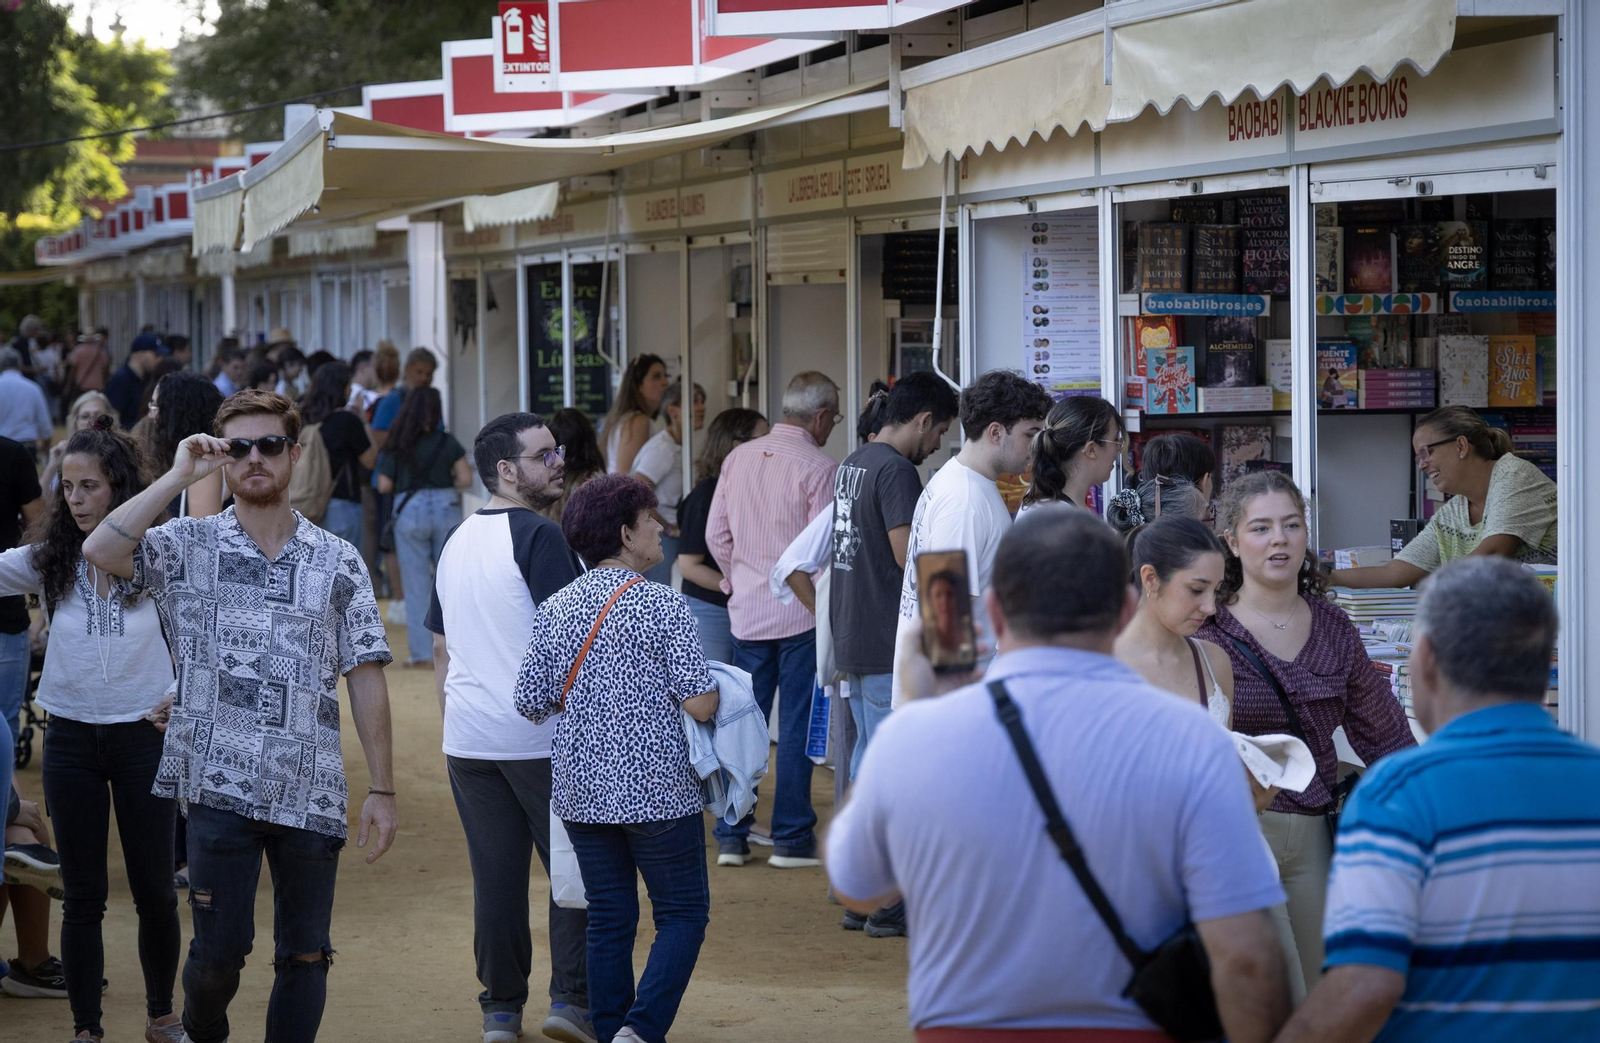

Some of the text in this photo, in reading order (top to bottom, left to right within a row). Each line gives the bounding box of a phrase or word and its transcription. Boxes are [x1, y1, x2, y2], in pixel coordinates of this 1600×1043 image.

[503, 62, 550, 72] EXTINTOR
[1299, 84, 1355, 132] BLACKIE
[1358, 76, 1408, 124] BOOKS
[1240, 196, 1284, 206] VICTORIA
[1240, 215, 1285, 228] HOJAS
[1245, 230, 1290, 239] VICTORIA
[1157, 236, 1170, 245] LA
[1211, 236, 1224, 246] LA
[1140, 247, 1187, 256] VOLUNTAD
[1195, 248, 1240, 257] VOLUNTAD
[1245, 248, 1290, 261] HOJAS
[1448, 246, 1483, 255] DESTINO
[1495, 248, 1537, 257] destinos
[1157, 259, 1170, 267] DE
[1211, 260, 1224, 268] DE
[1244, 269, 1290, 278] DEDALERA
[1495, 263, 1536, 275] infinitos
[1144, 270, 1183, 279] MUCHOS
[1199, 270, 1237, 280] MUCHOS
[1148, 298, 1262, 311] baobablibros.es
[1208, 343, 1254, 351] ALCHEMISED
[1317, 350, 1350, 358] PUENTE
[1319, 362, 1348, 370] ALMAS
